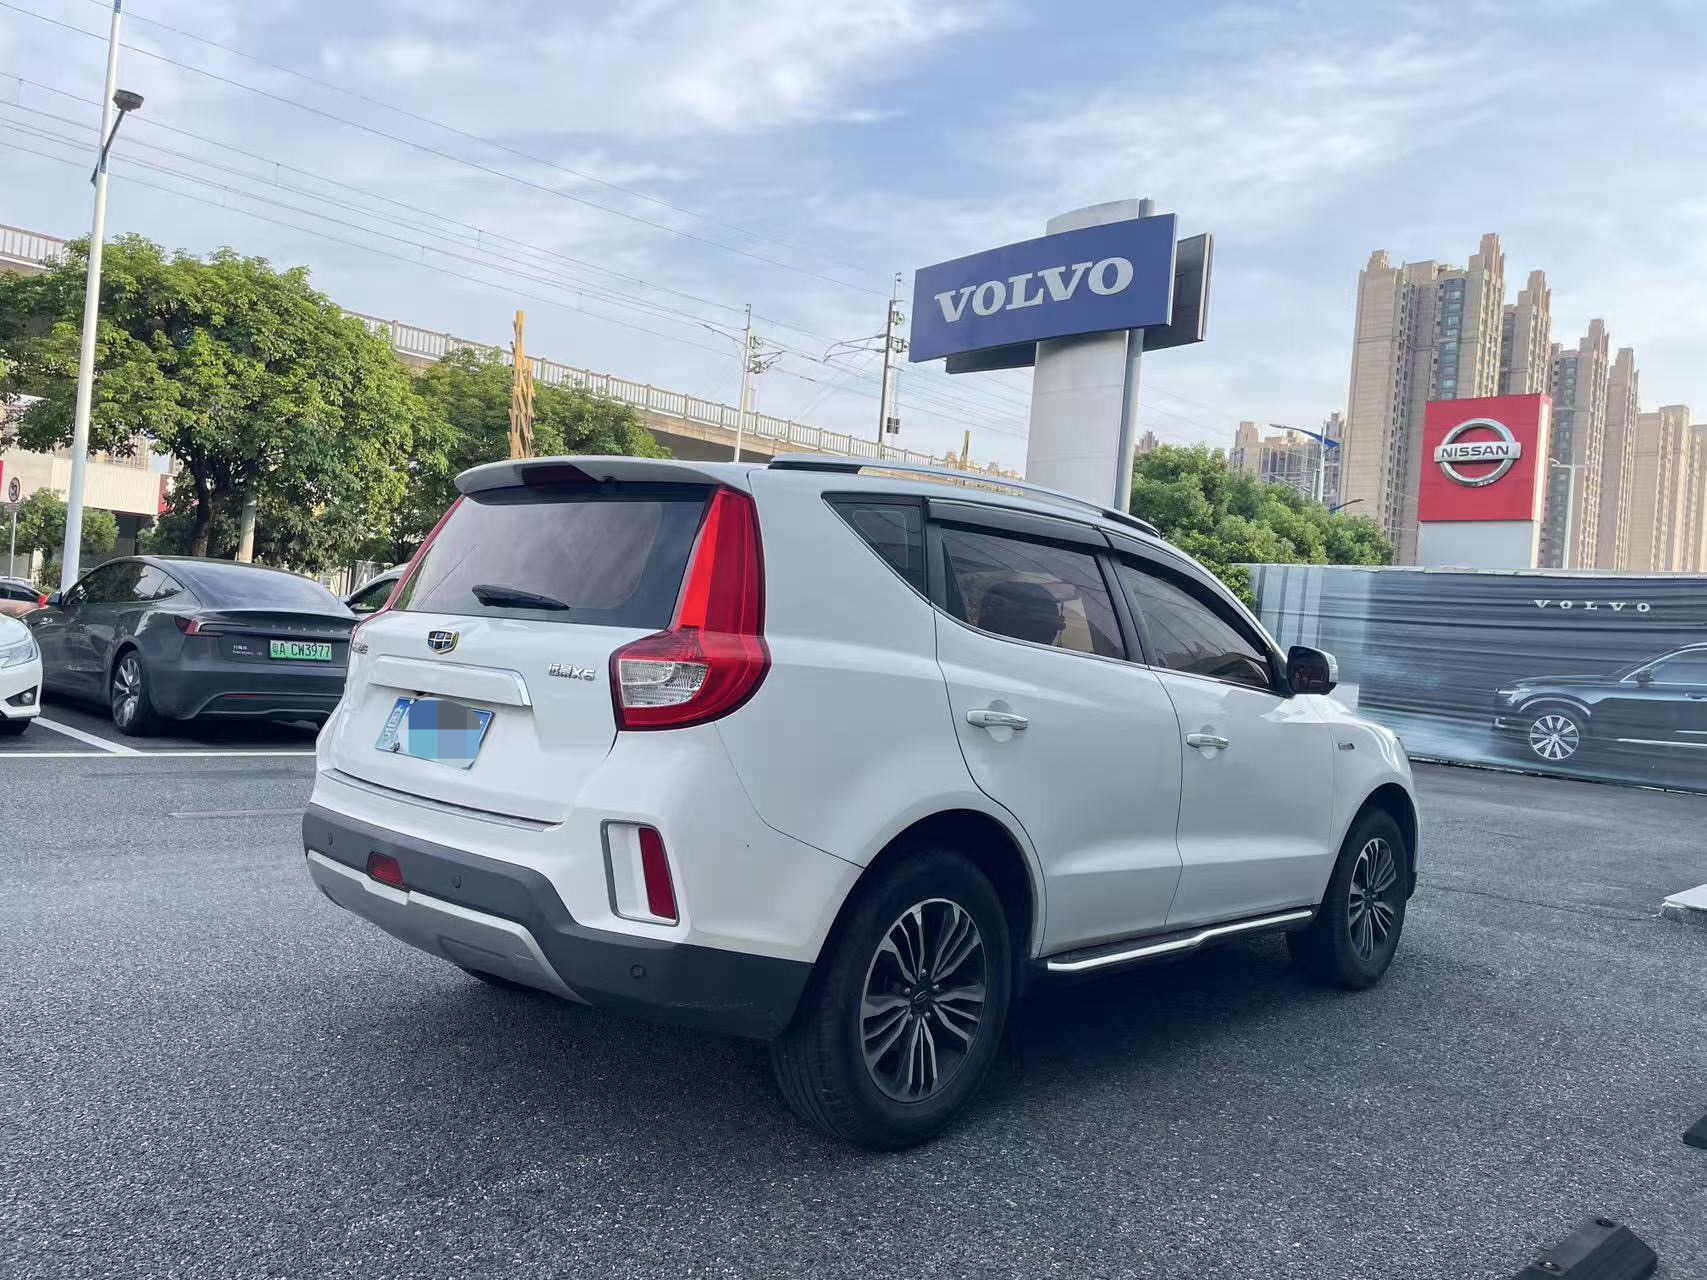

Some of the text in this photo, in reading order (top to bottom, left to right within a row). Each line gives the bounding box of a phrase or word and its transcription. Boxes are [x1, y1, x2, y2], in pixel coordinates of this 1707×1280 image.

[934, 257, 1134, 323] VOLVO
[1441, 445, 1509, 458] NISSAN
[1533, 599, 1651, 612] VOLVO
